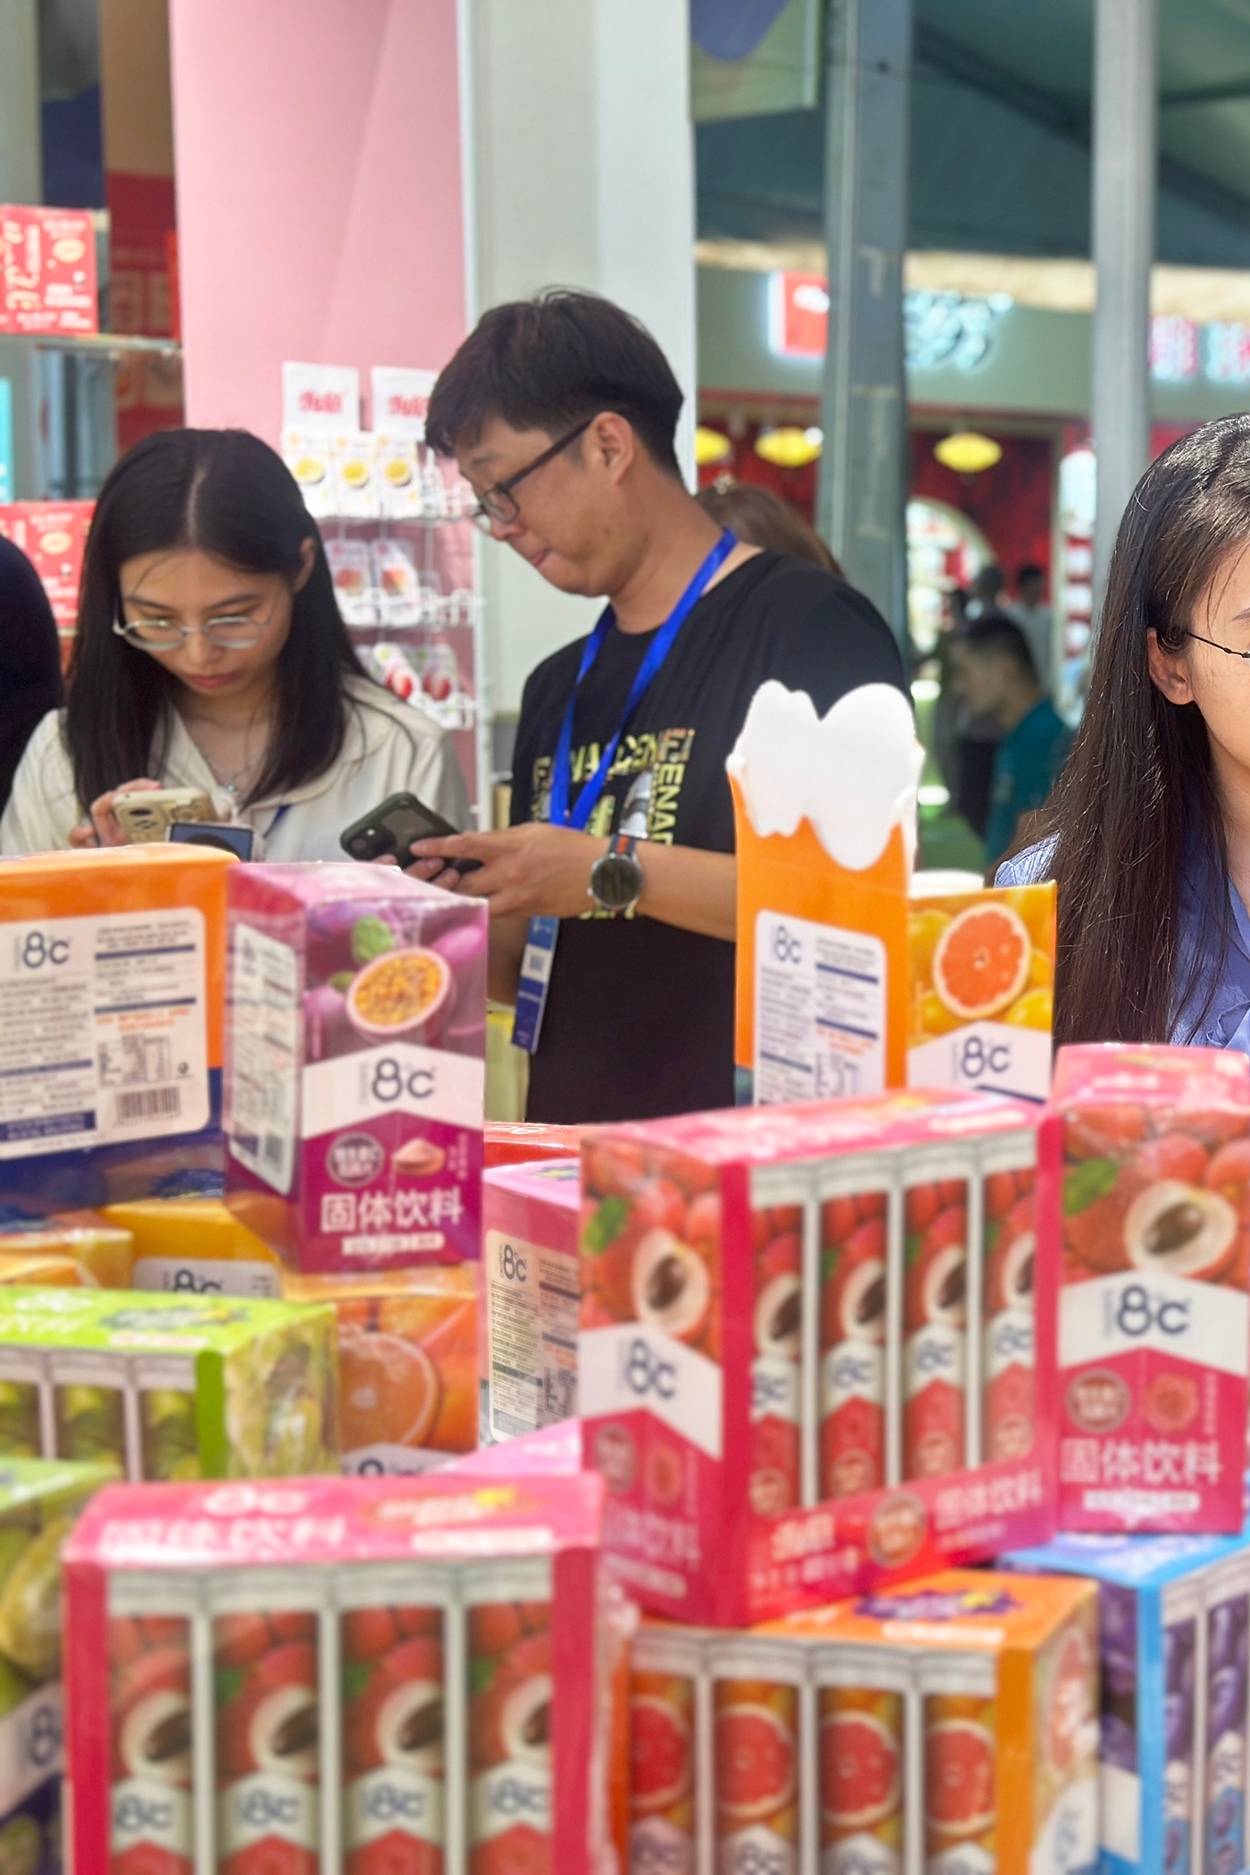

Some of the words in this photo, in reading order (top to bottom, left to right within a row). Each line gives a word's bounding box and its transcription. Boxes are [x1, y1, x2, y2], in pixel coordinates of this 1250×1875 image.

[321, 1187, 464, 1233] 固体饮料
[1061, 1439, 1222, 1484] 固体饮料
